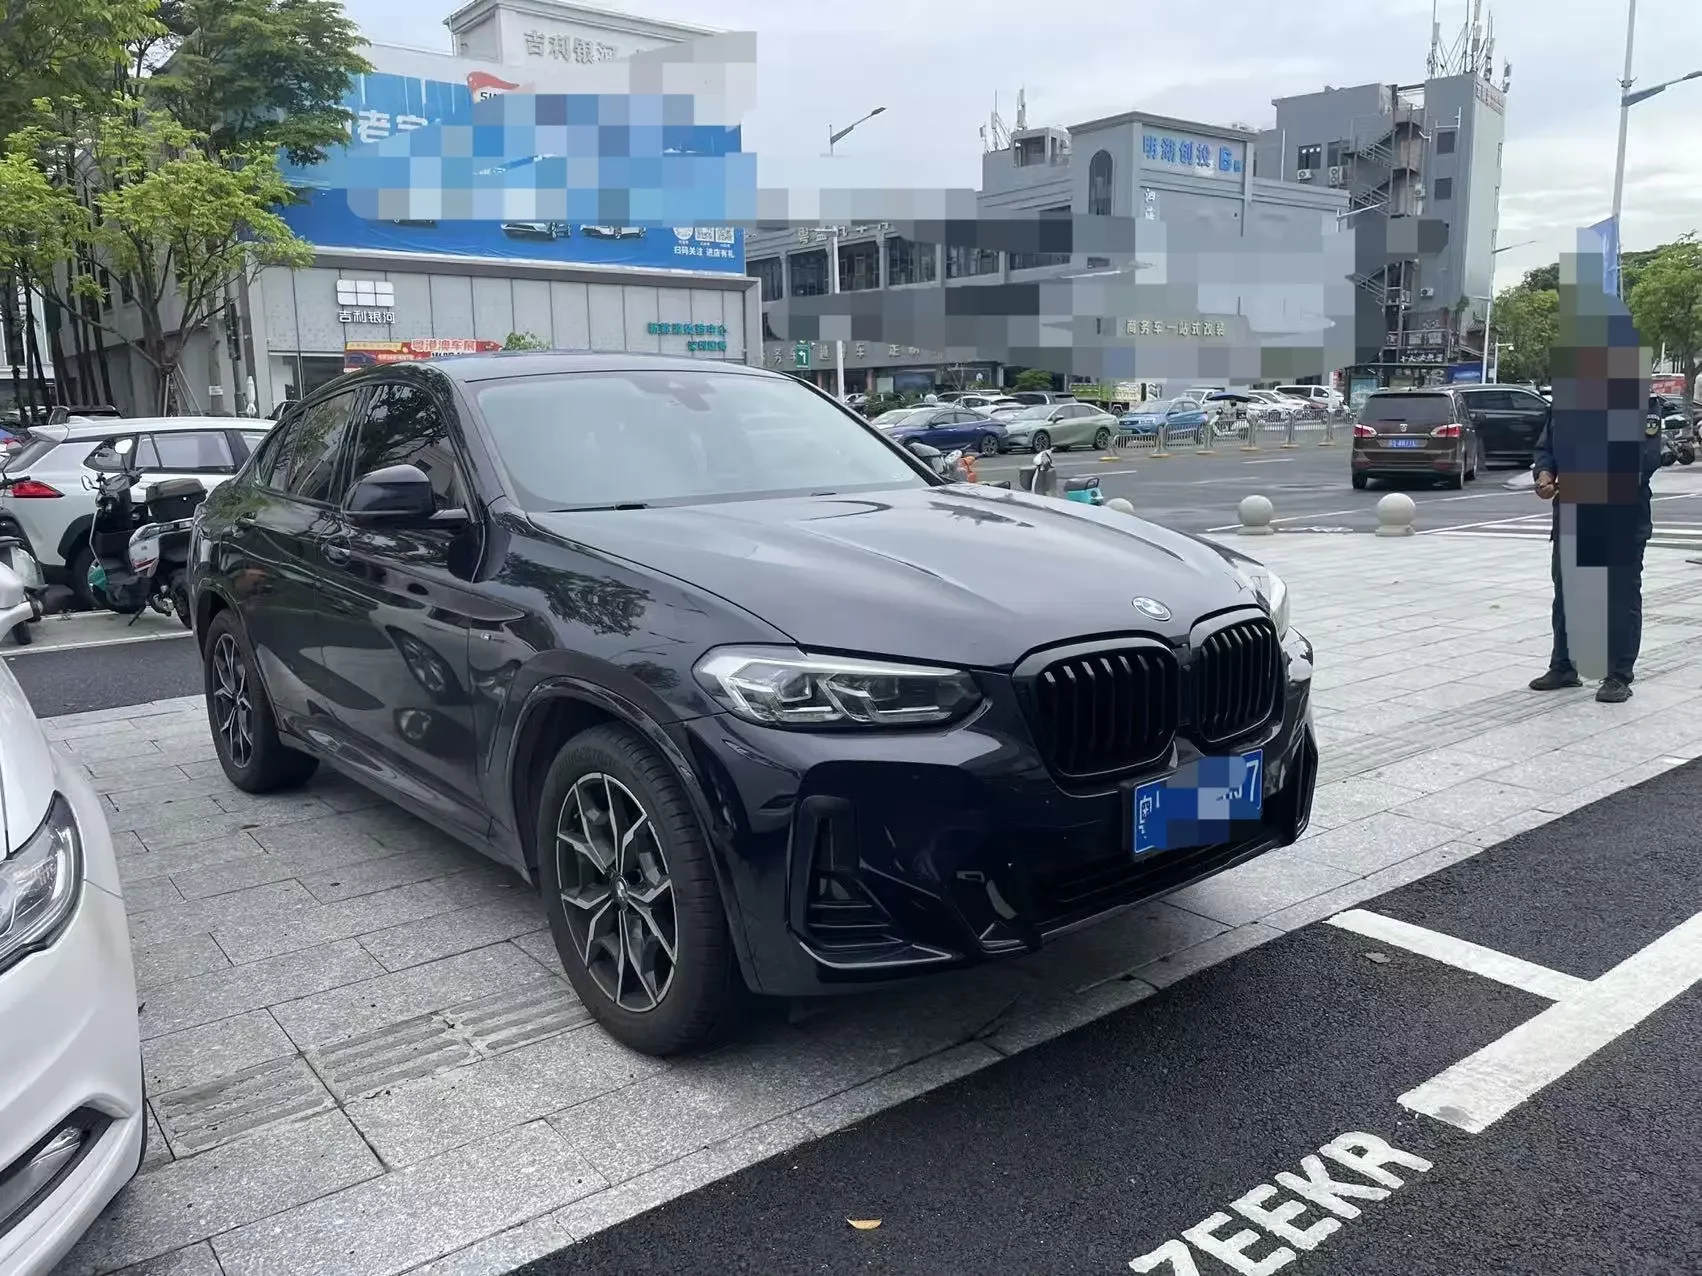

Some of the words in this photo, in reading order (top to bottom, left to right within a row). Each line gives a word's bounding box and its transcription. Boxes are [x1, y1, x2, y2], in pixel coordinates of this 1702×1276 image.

[339, 311, 395, 323] 吉利银河
[1126, 320, 1225, 336] 商务车一站式改装
